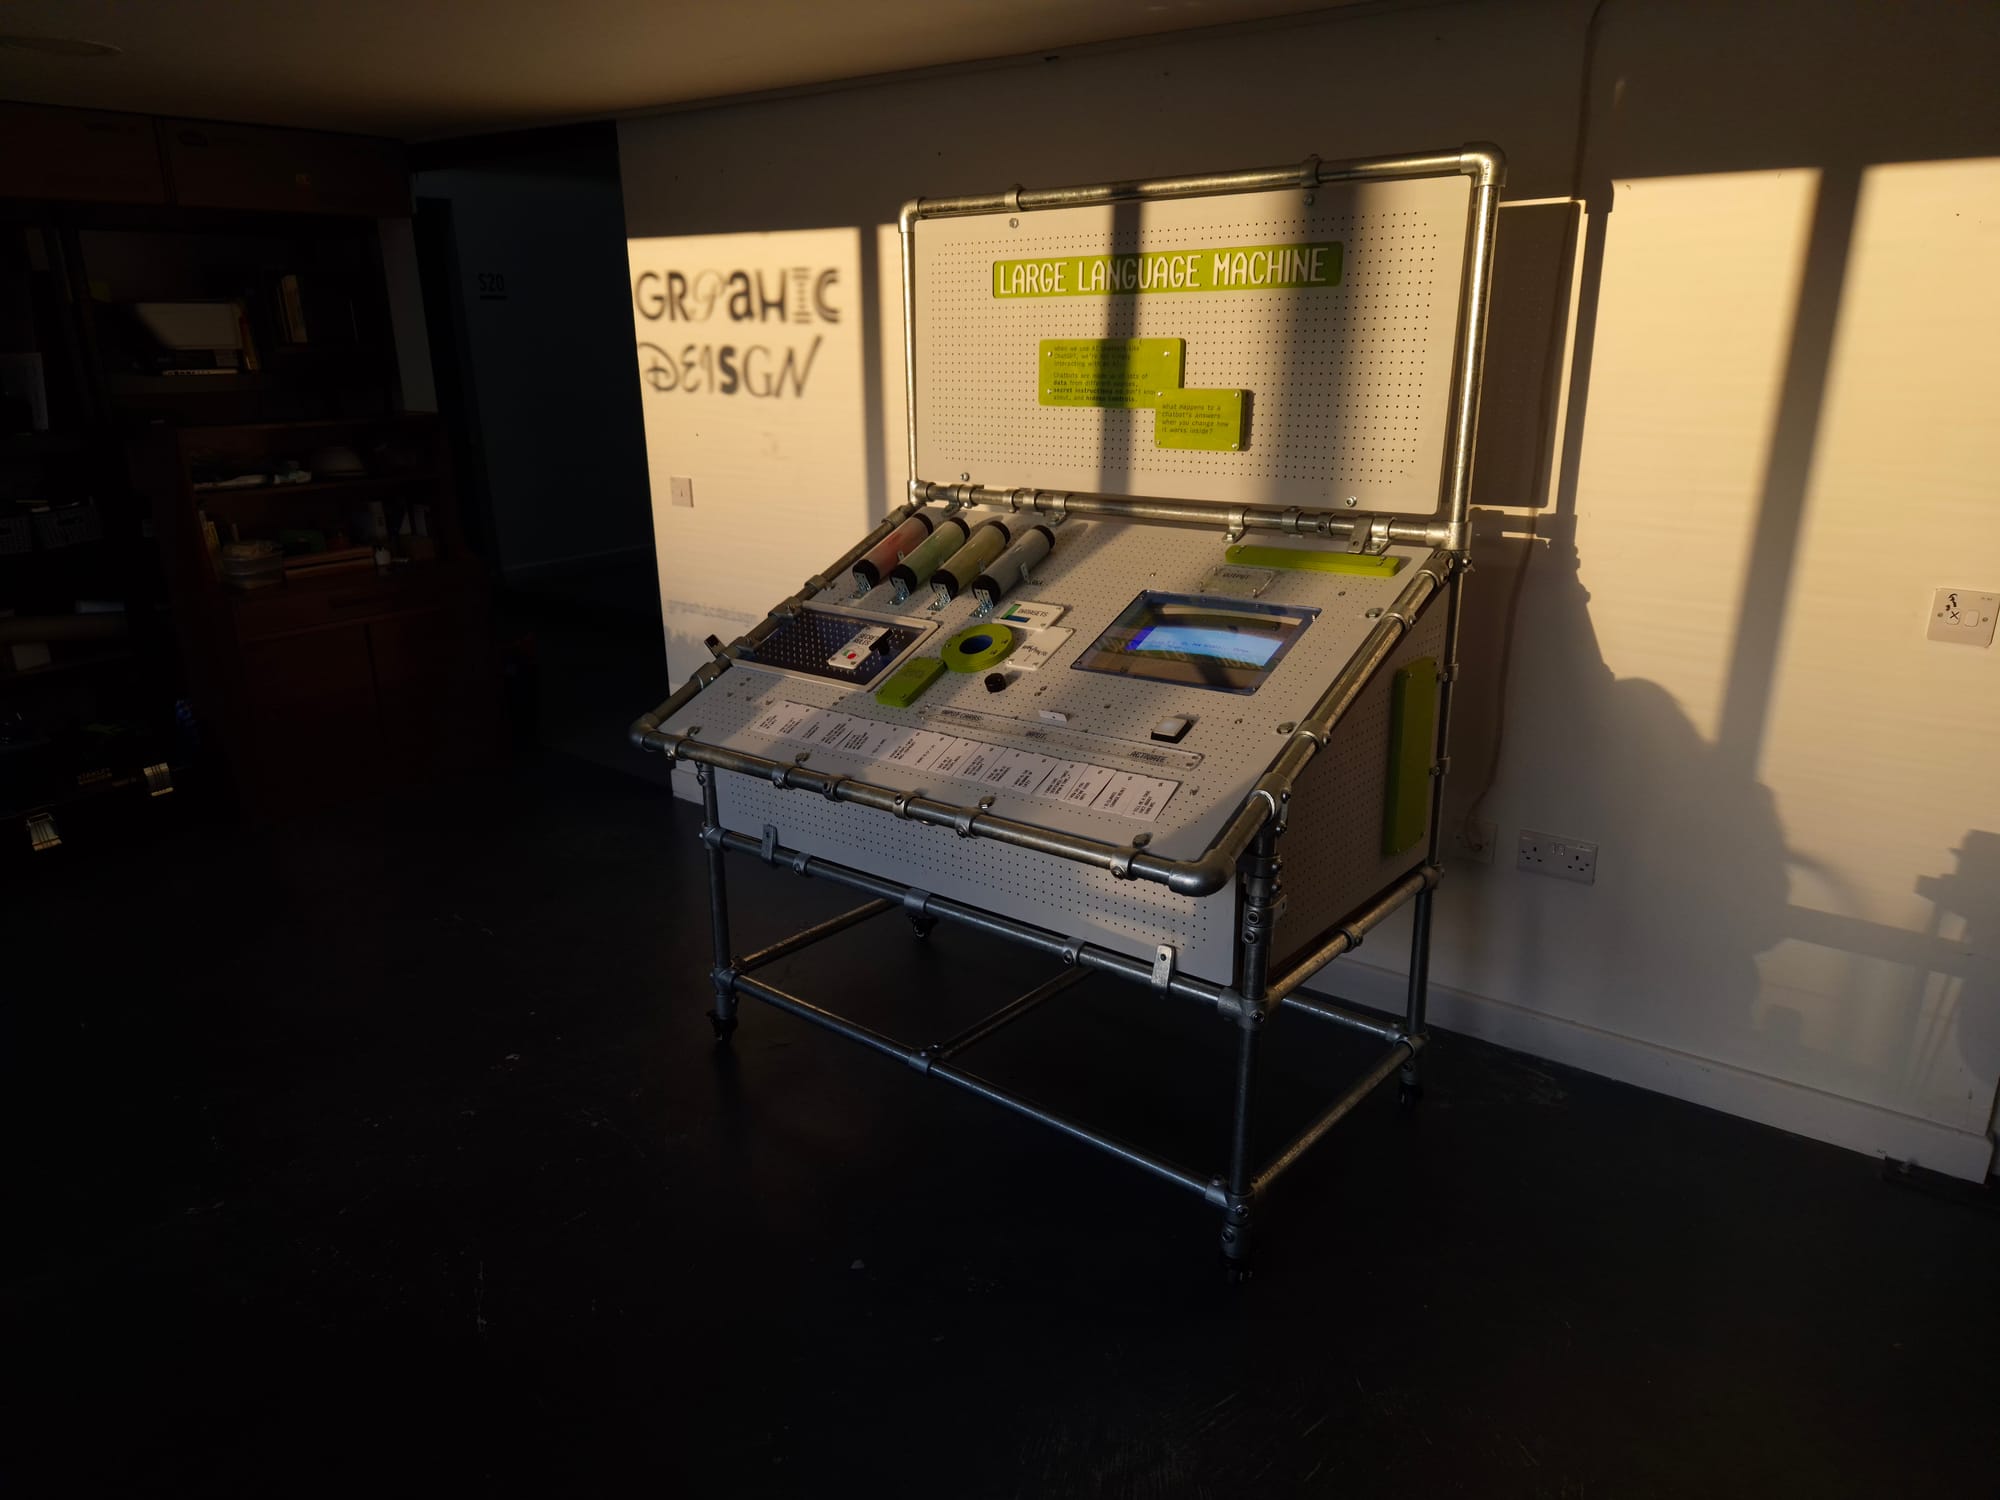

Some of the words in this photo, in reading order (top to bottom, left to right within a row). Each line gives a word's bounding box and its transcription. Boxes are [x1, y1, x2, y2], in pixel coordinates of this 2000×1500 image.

[478, 272, 505, 292] S20
[1000, 261, 1068, 294] LARGE
[1077, 254, 1203, 292] LANGUAGE
[1213, 247, 1329, 287] MACHINE
